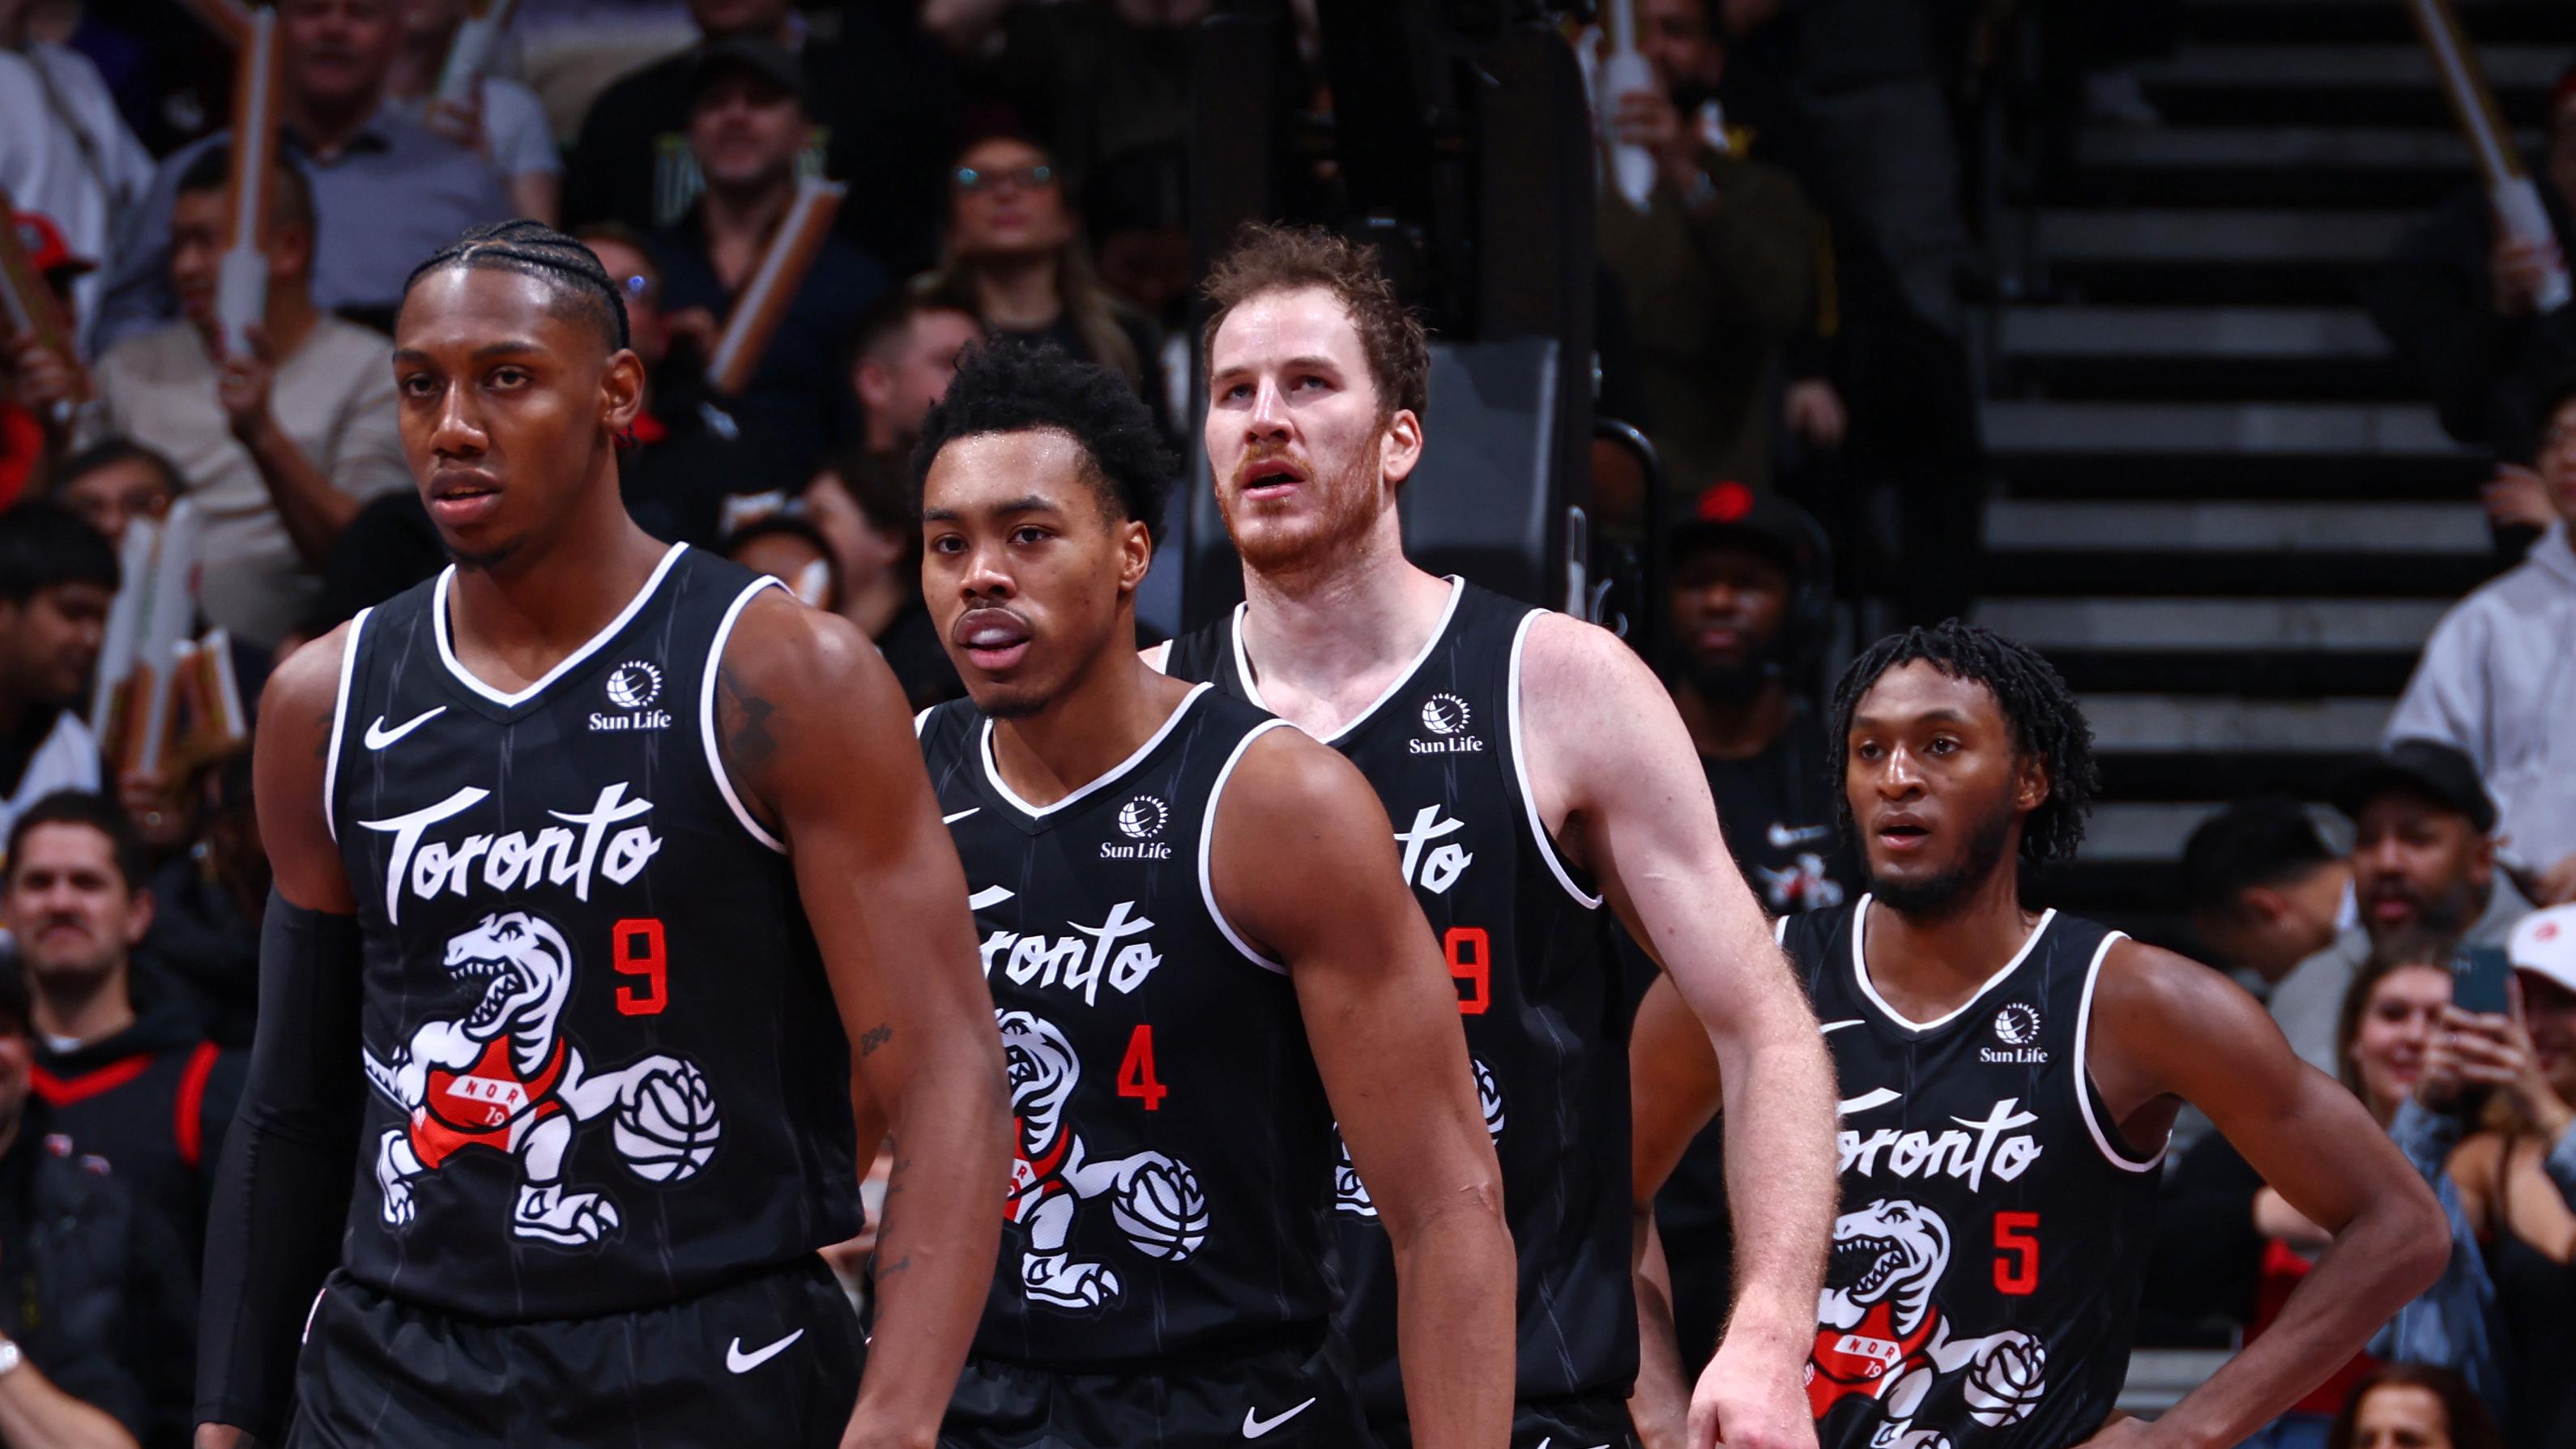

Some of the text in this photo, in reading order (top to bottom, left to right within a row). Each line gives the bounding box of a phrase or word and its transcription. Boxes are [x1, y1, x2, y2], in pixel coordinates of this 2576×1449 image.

[589, 710, 672, 731] Sun Life
[1409, 735, 1483, 754] Sun Life
[358, 782, 663, 926] Toronto
[1099, 842, 1172, 859] Sun Life
[612, 918, 667, 1016] 9
[1980, 1045, 2049, 1063] Sun Life
[1117, 1025, 1167, 1110] 4
[484, 1106, 505, 1127] 19
[1994, 1212, 2040, 1295] 5
[1864, 1361, 1883, 1379] 19
